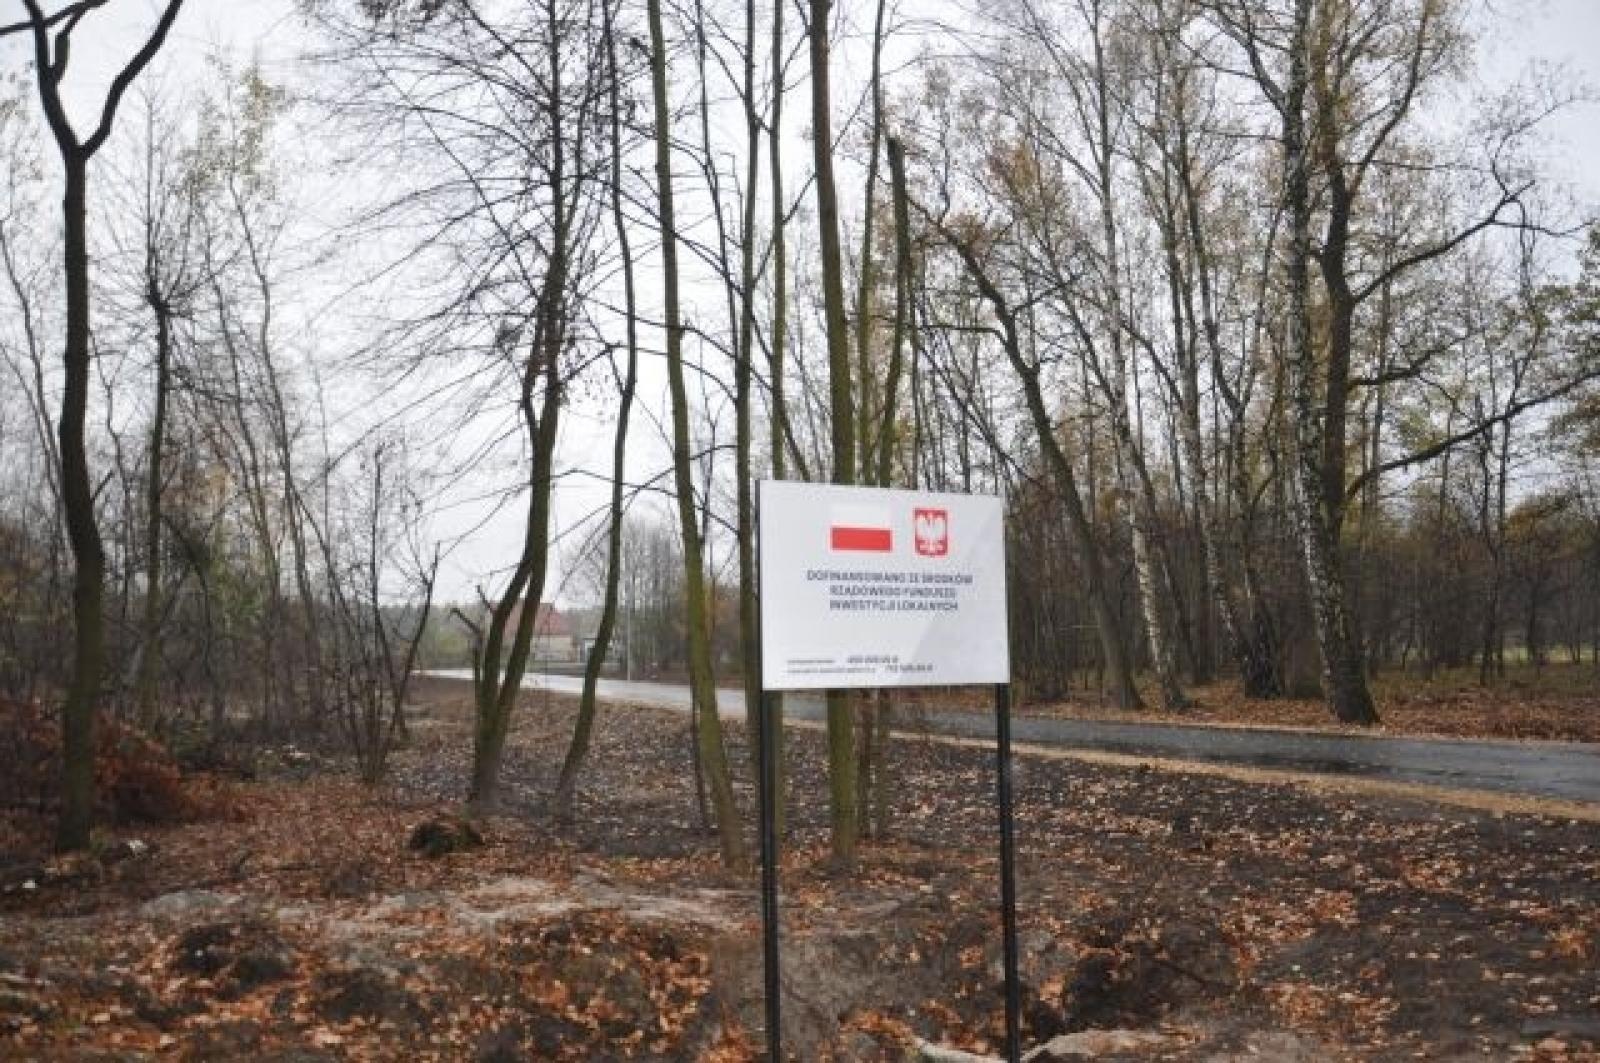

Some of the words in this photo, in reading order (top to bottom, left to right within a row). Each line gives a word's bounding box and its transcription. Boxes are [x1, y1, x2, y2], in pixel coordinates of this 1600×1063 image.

[807, 569, 905, 583] DOFINANSOWANO
[909, 572, 920, 583] ZE
[829, 599, 896, 611] INWESTYCJI
[898, 600, 958, 611] LOKALNYCH
